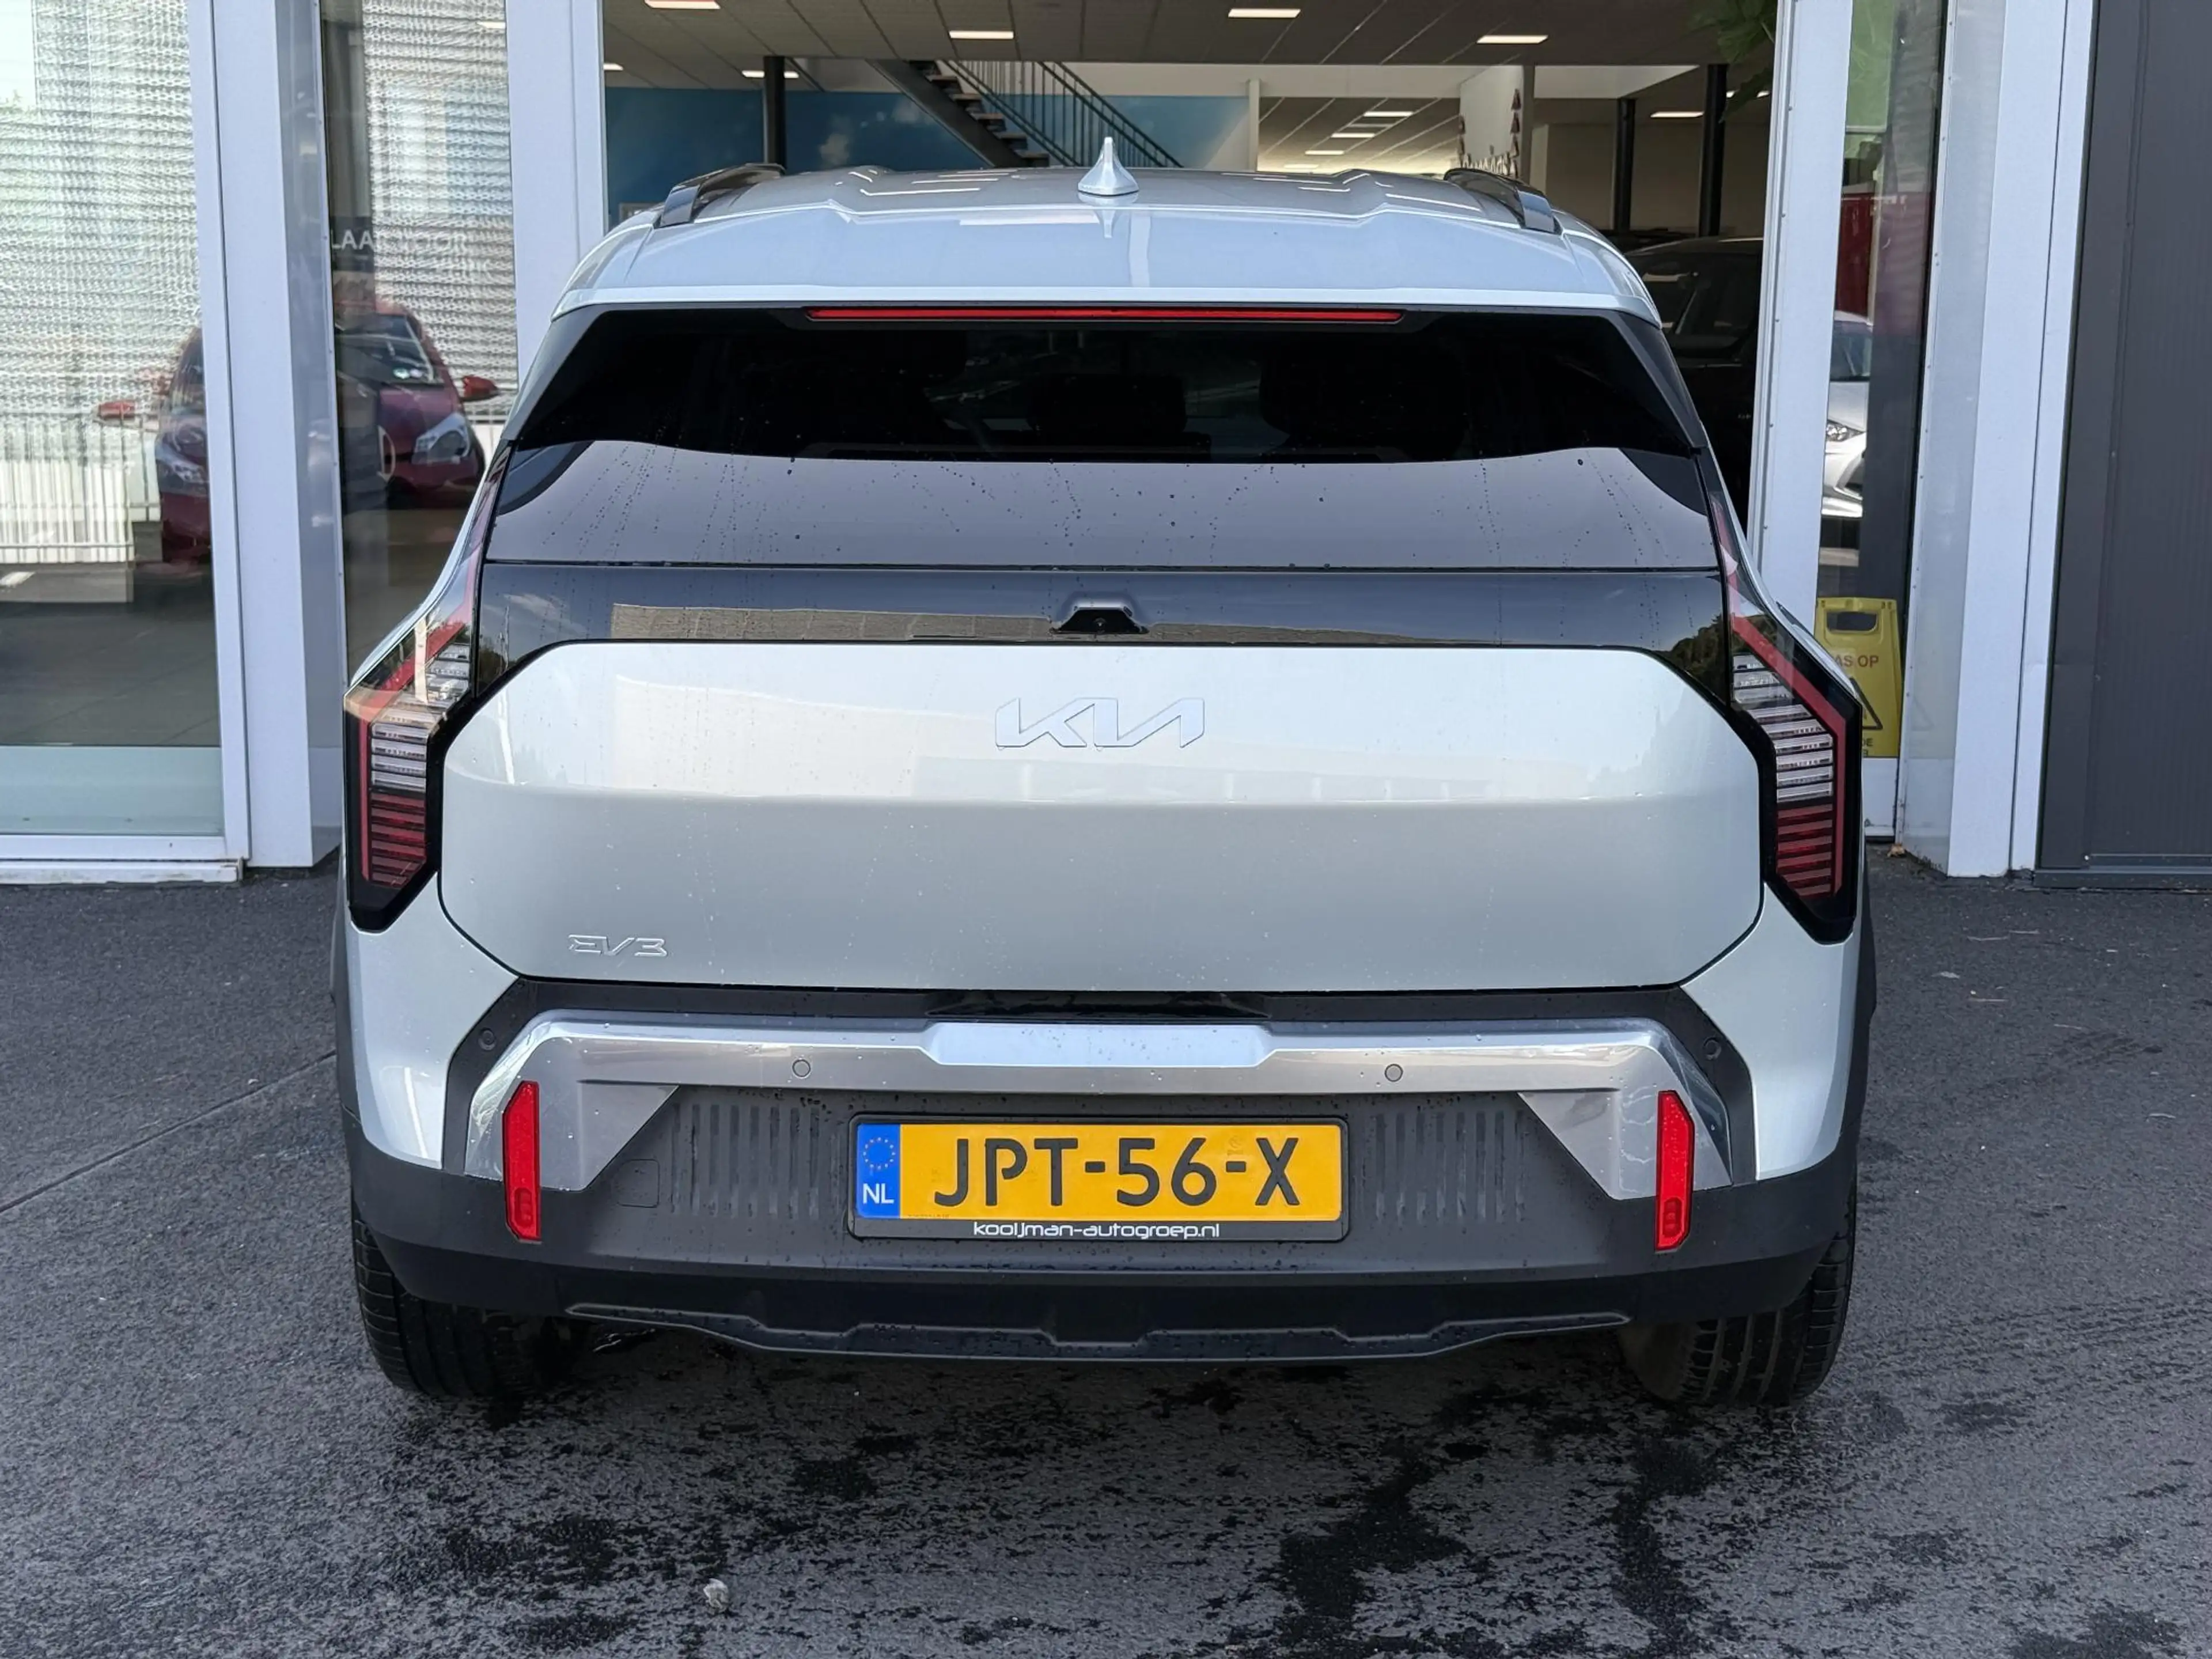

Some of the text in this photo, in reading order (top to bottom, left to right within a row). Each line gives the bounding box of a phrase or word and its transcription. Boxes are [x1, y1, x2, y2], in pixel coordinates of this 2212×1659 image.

[1858, 654, 1879, 668] OP
[995, 698, 1205, 748] KIA
[569, 934, 667, 956] EV3
[934, 1137, 1300, 1206] JPT-56-X
[863, 1183, 894, 1205] NL
